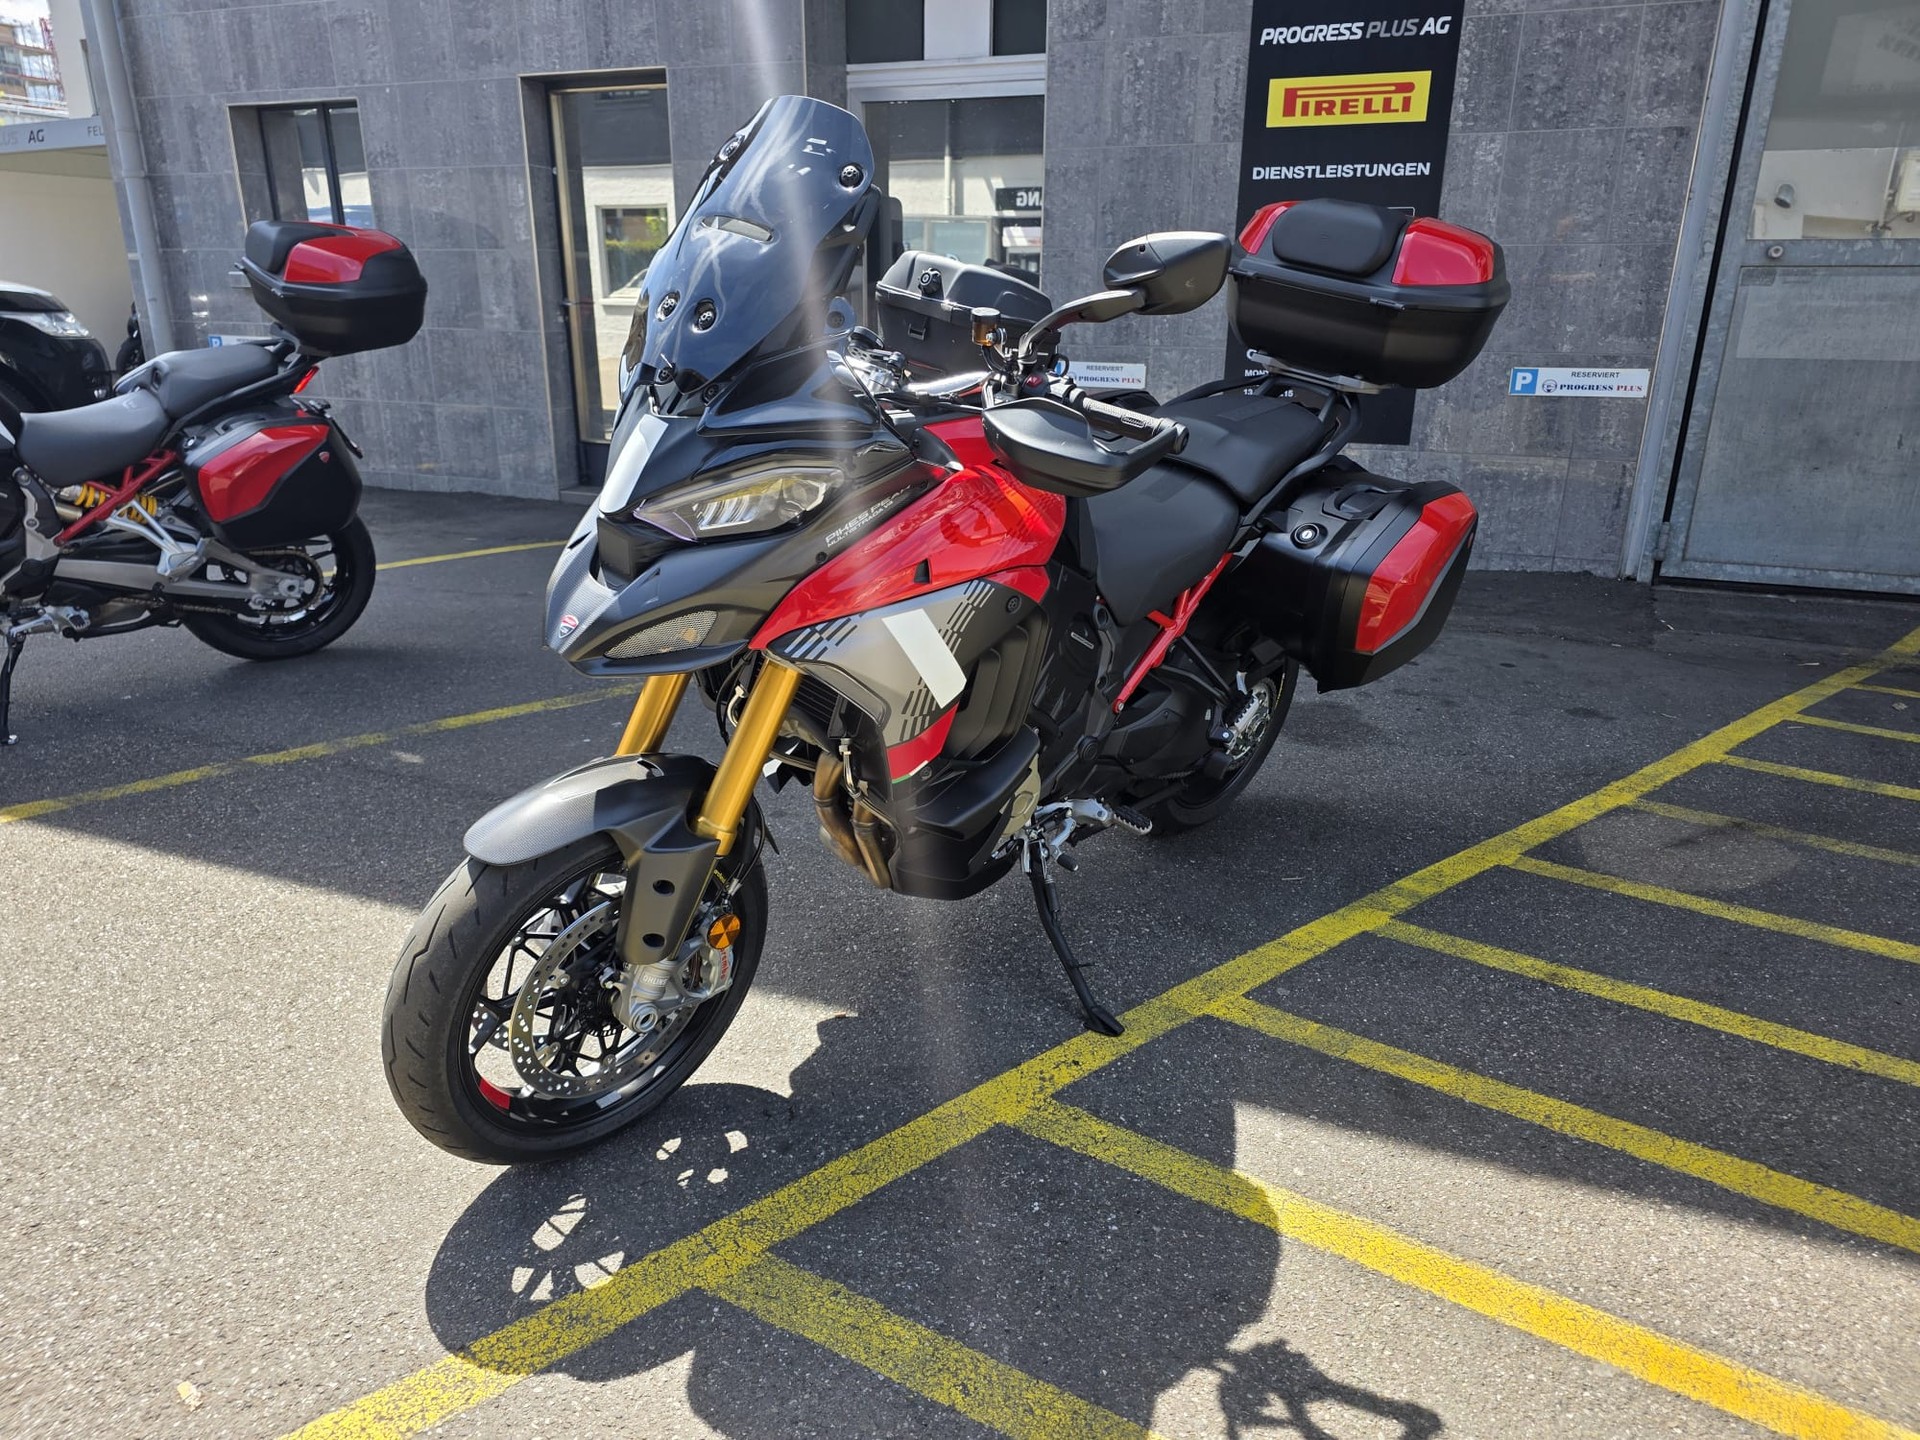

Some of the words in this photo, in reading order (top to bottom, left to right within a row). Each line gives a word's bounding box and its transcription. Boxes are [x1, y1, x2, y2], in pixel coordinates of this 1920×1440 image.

[1260, 21, 1365, 46] PROGRESS
[1366, 18, 1420, 39] PLUS
[1419, 15, 1452, 36] AG
[1282, 81, 1416, 118] PIRELLI
[28, 129, 45, 143] AG
[1252, 162, 1431, 180] DIENSTLEISTUNGEN
[1571, 371, 1620, 379] RESERVIERT
[1560, 384, 1614, 392] PROGRESS
